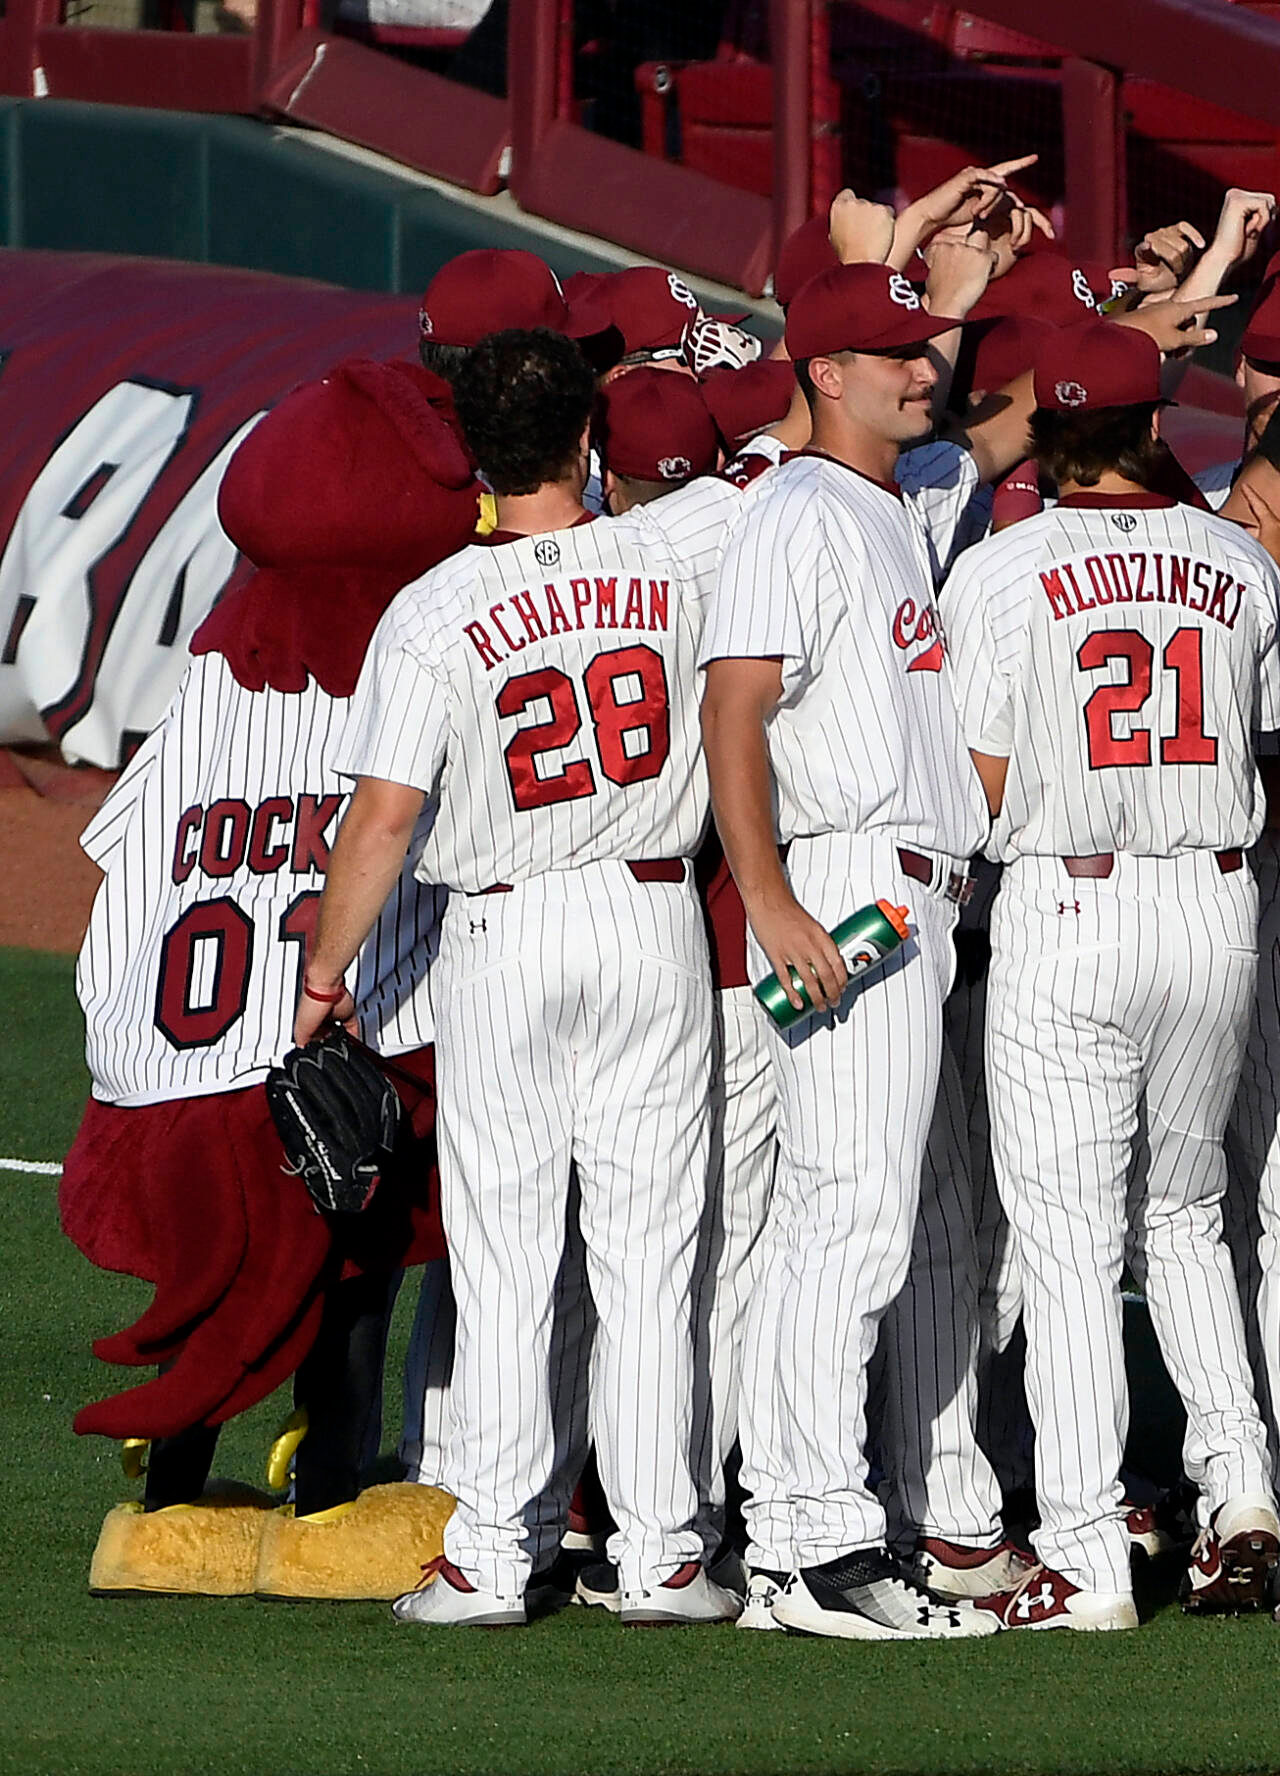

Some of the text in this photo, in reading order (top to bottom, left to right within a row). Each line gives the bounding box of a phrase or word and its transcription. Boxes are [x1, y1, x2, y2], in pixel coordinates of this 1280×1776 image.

[1039, 552, 1247, 631] MLODZINSKI
[494, 642, 671, 813] 28
[1076, 626, 1219, 771] 21
[171, 793, 348, 886] COCK
